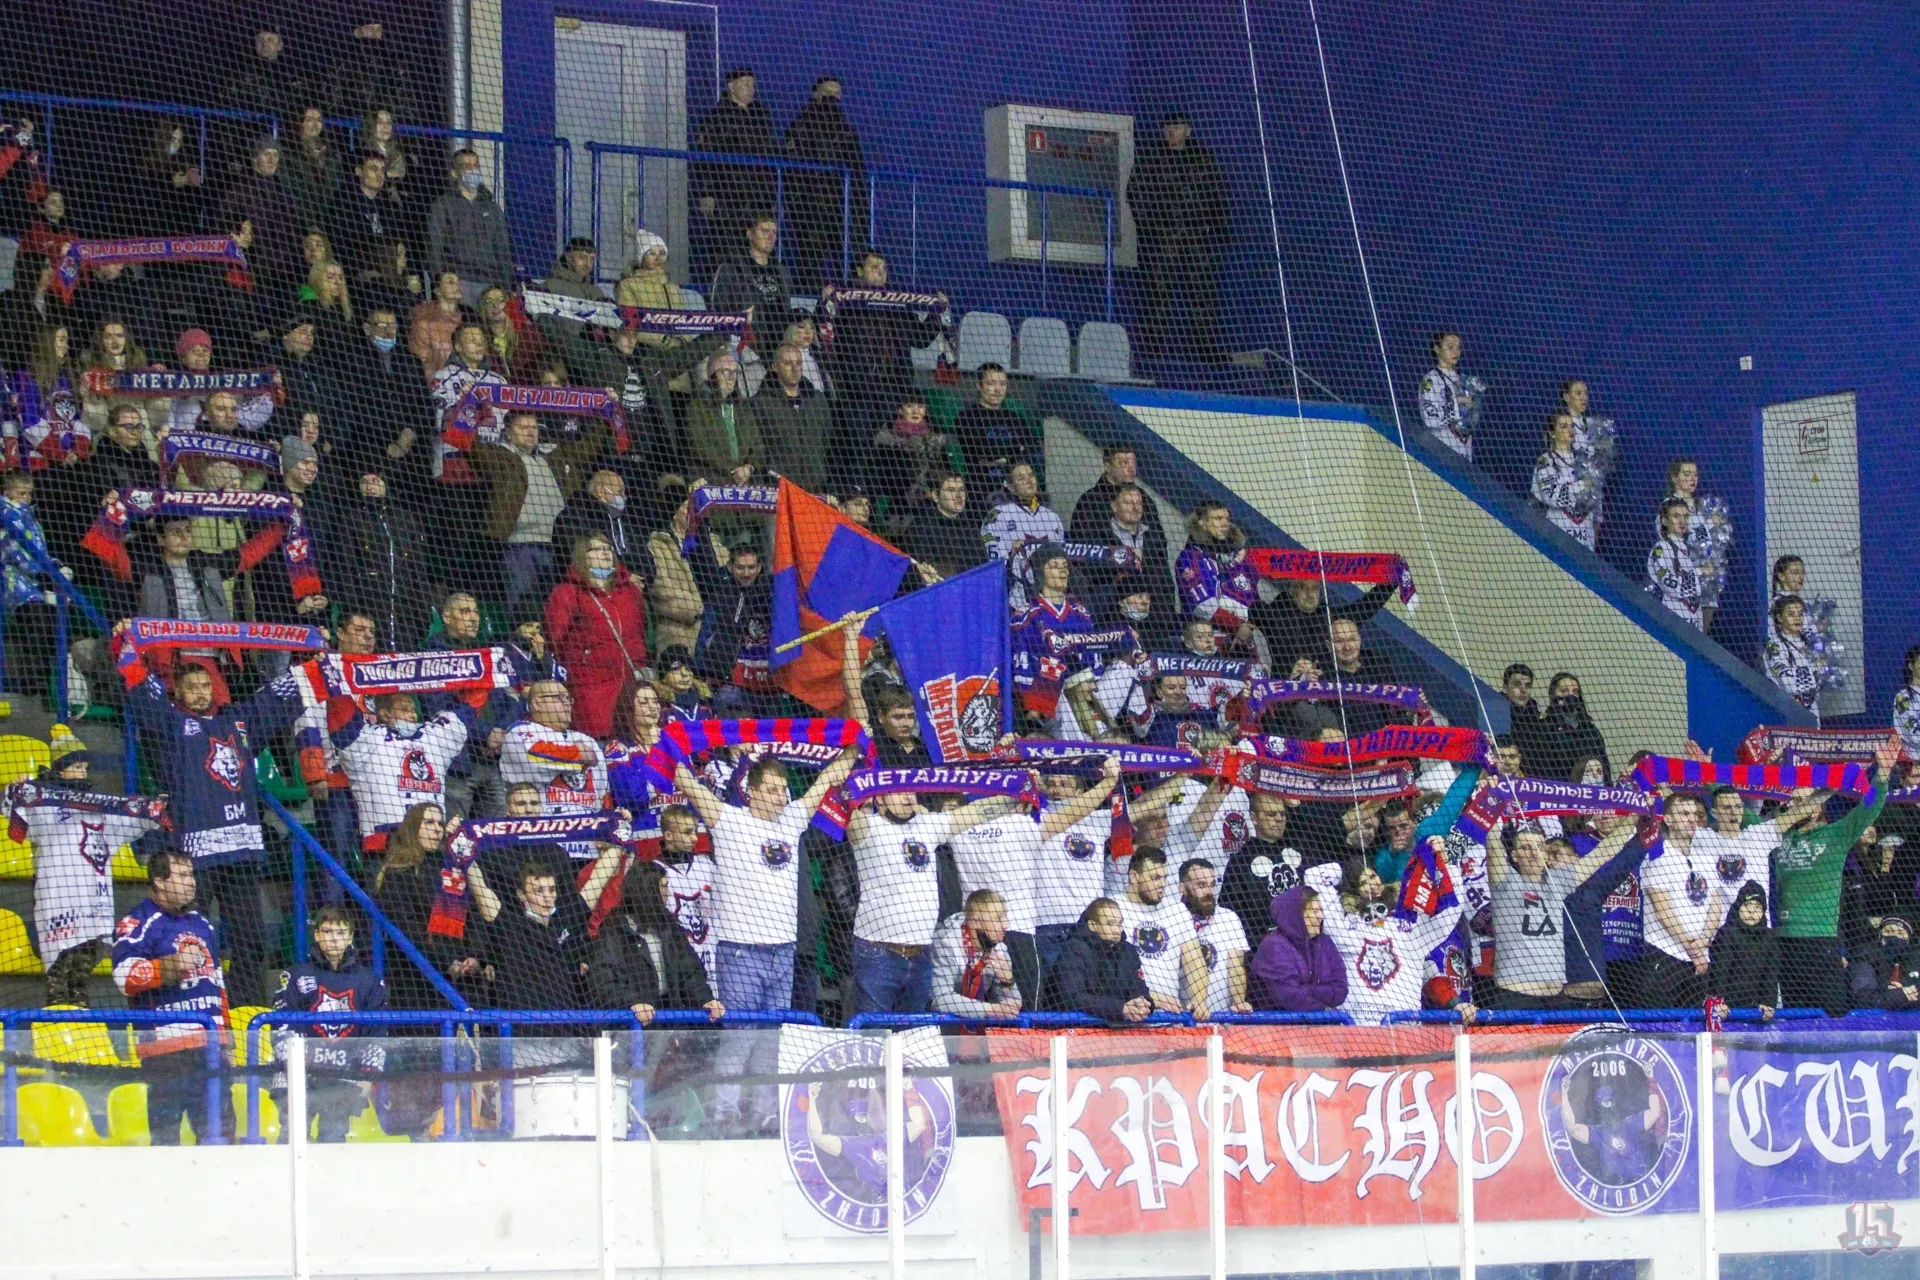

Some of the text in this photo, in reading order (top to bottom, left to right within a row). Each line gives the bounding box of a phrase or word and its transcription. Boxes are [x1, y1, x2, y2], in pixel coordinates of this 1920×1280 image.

[836, 291, 939, 304] МЕТАЛЛУРГ
[641, 312, 746, 325] МЕТАЛЛУРГ
[132, 373, 261, 388] МЕТАЛЛУРГ
[162, 491, 292, 509] МЕТАЛЛУРГ
[1269, 552, 1379, 576] МЕТАЛЛУРГ
[138, 621, 309, 643] СТАЛЬНЫЕ ВОЛКИ
[357, 660, 416, 681] ТОЛЬКО
[420, 655, 478, 679] ПОБЕДА
[1156, 657, 1246, 674] МЕТАЛЛУРГ
[1252, 680, 1415, 701] МЕТАЛЛУРГ
[853, 769, 1018, 791] МЕТАЛЛУРГ
[1498, 780, 1594, 801] СТАЛЬНЫЕ
[472, 818, 609, 838] МЕТАЛЛУРГ
[314, 1047, 347, 1067] БМЗ
[1592, 1060, 1626, 1077] 2006
[1016, 1070, 1524, 1210] КРАСНО
[1575, 1171, 1663, 1207] ZHLOBIN
[820, 1188, 928, 1227] ZHLOIN
